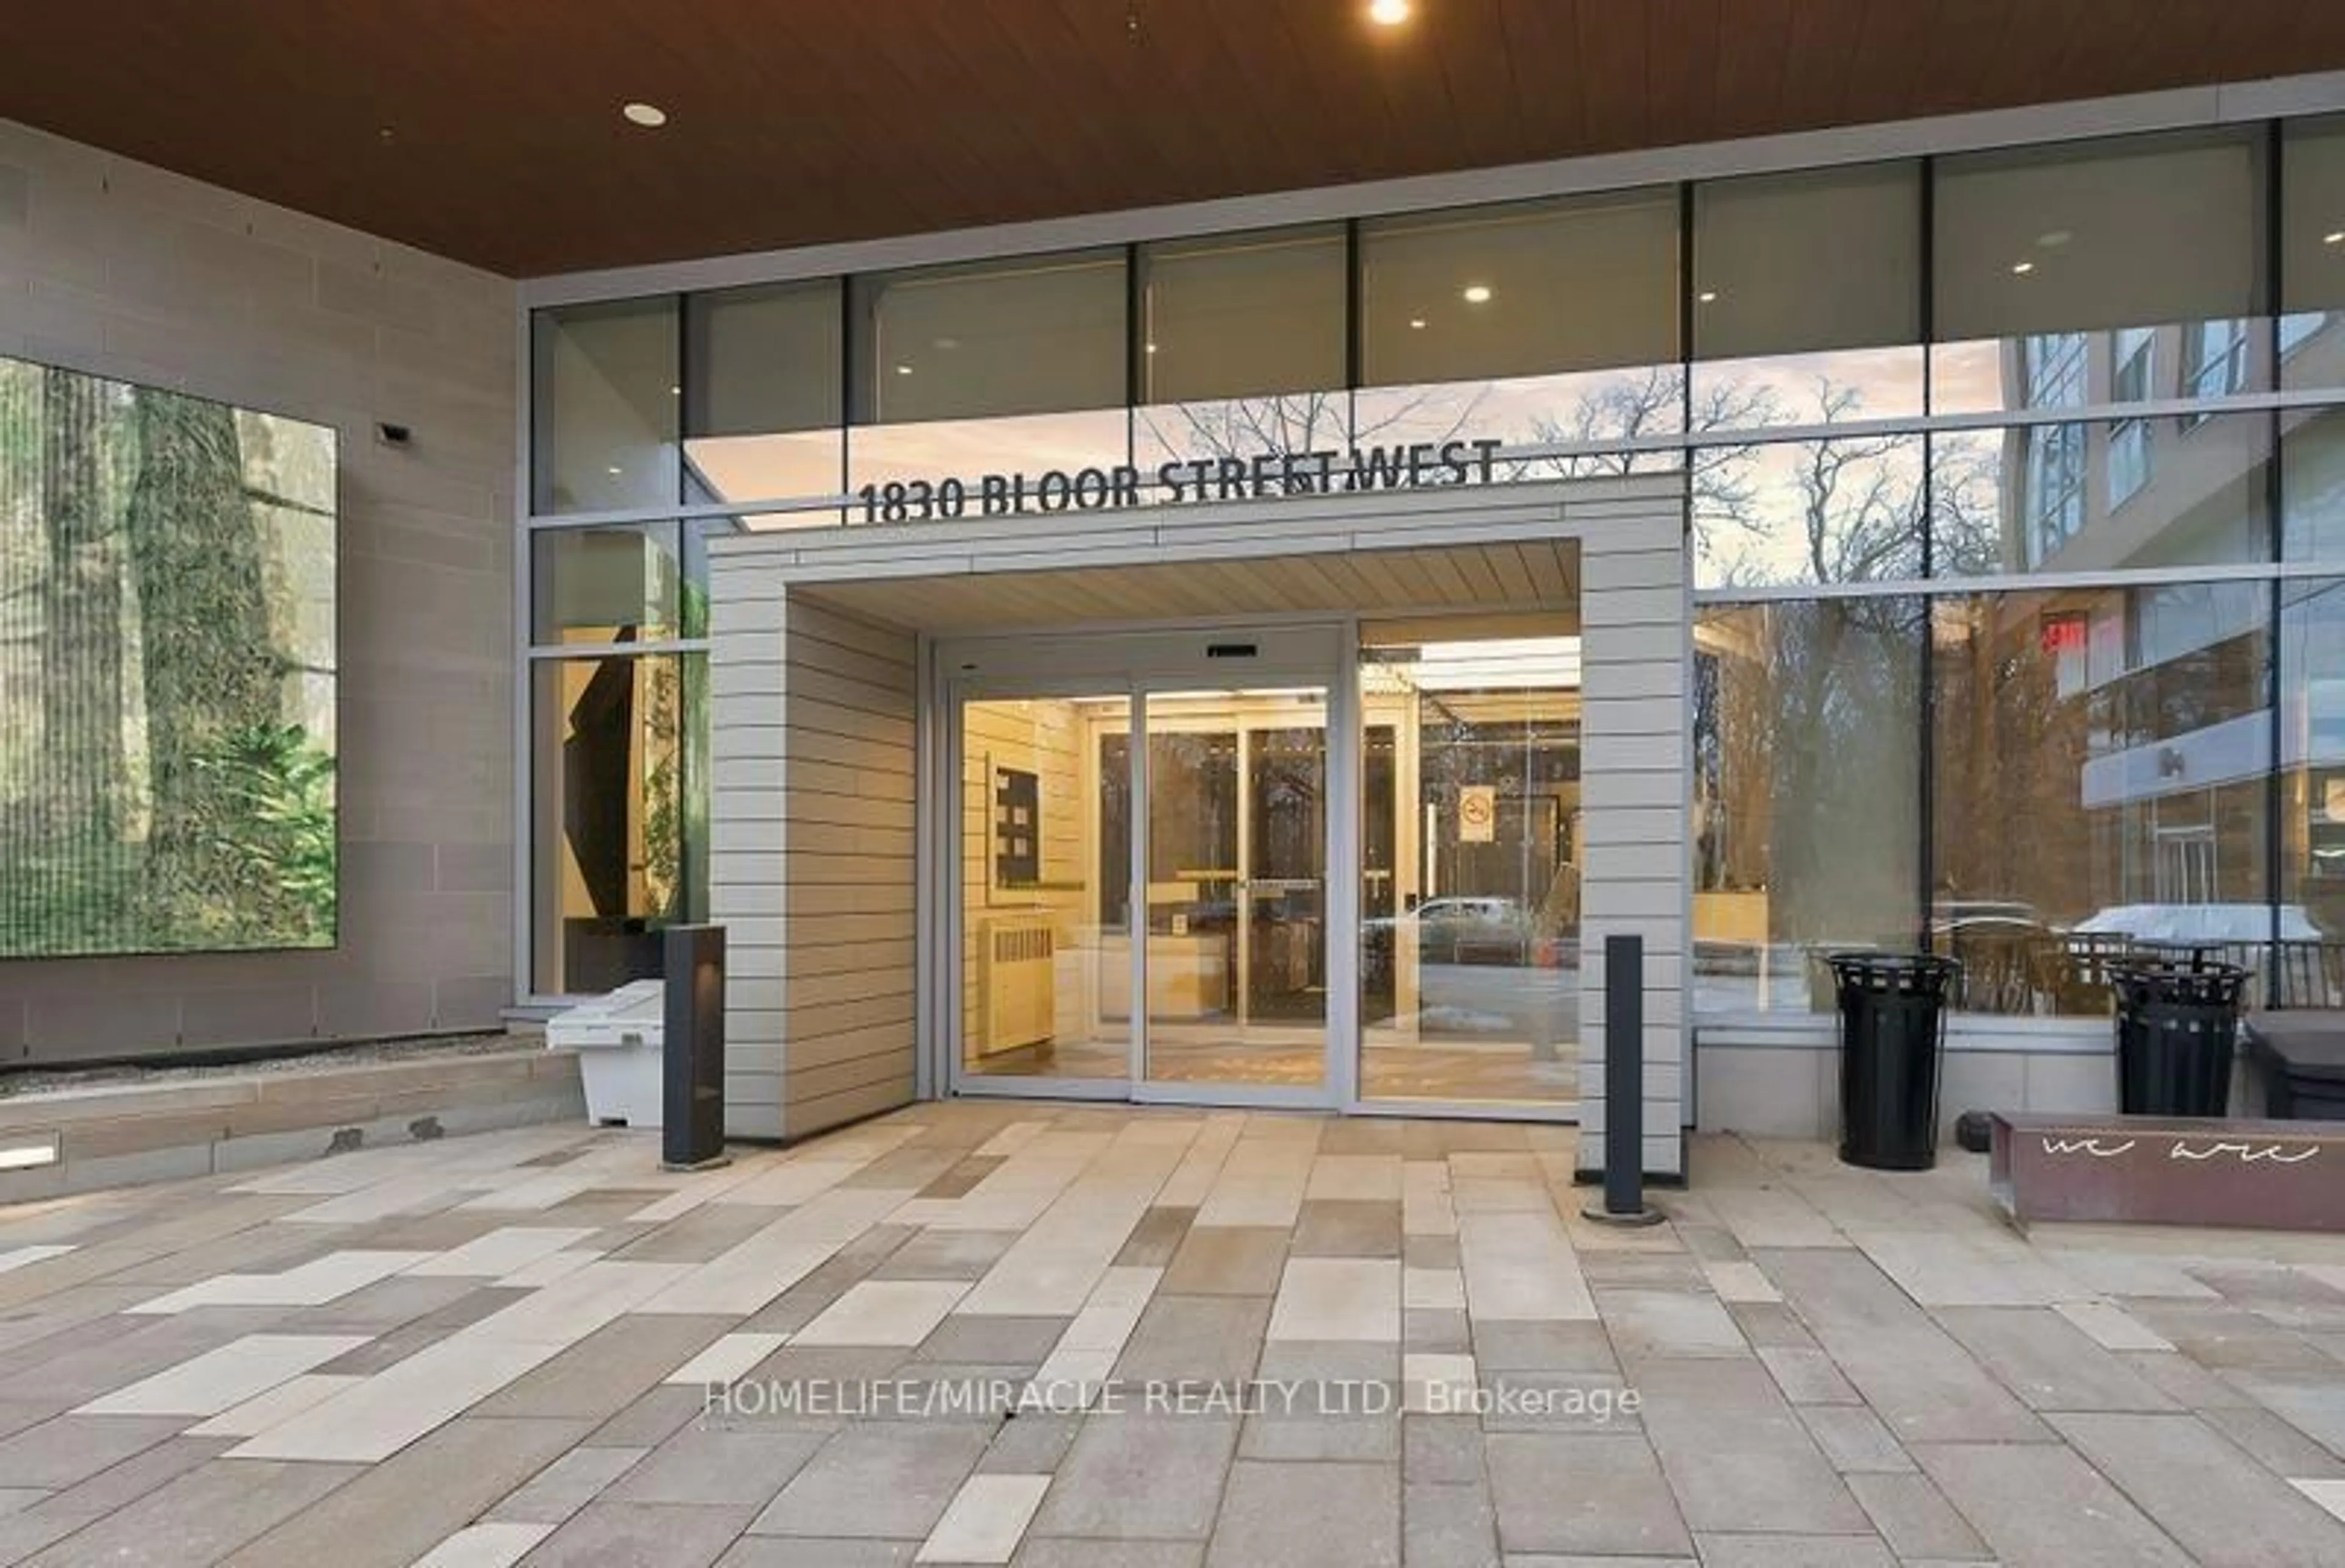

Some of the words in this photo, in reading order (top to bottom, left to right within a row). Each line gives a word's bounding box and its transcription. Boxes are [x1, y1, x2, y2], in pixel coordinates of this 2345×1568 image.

[859, 477, 964, 523] 1830
[982, 465, 1139, 515] BLOOR
[1160, 451, 1338, 502] STREET
[1347, 440, 1502, 490] WEST
[2042, 1137, 2136, 1156] we
[2170, 1141, 2320, 1161] are
